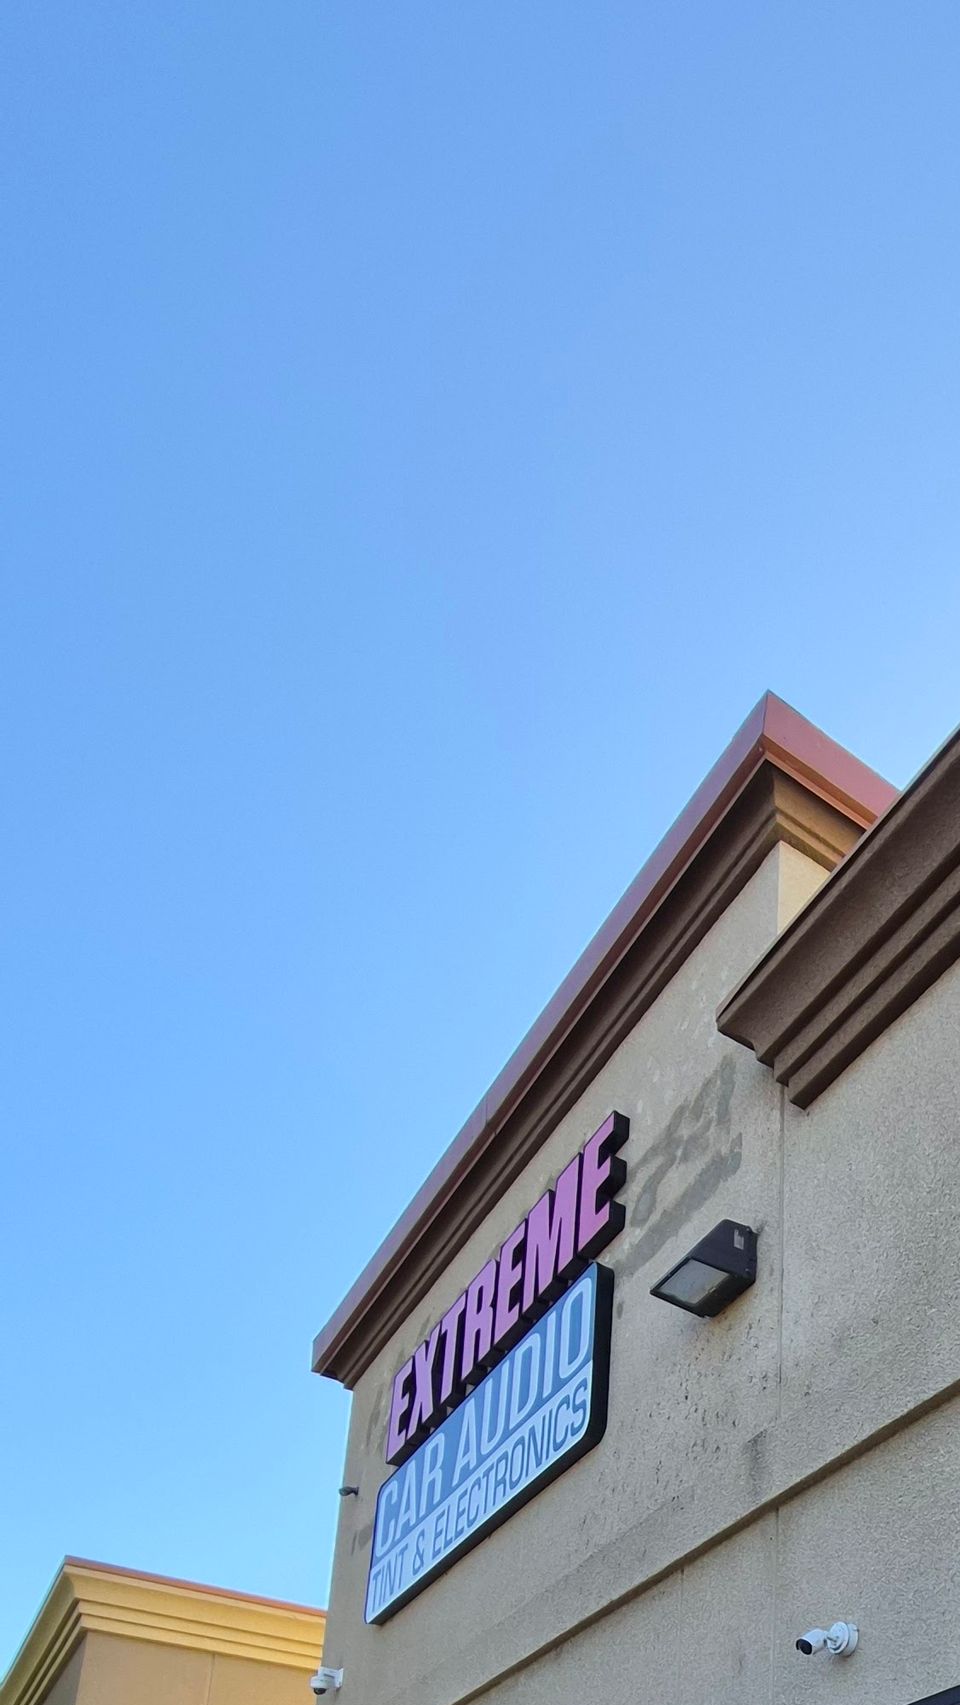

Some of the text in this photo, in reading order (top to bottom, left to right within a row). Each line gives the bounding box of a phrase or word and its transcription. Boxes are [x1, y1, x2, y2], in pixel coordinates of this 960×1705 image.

[375, 1277, 592, 1557] CAR AUDIO
[386, 1111, 620, 1464] EXTREME
[371, 1378, 588, 1612] TINT & ELECTRONICS
